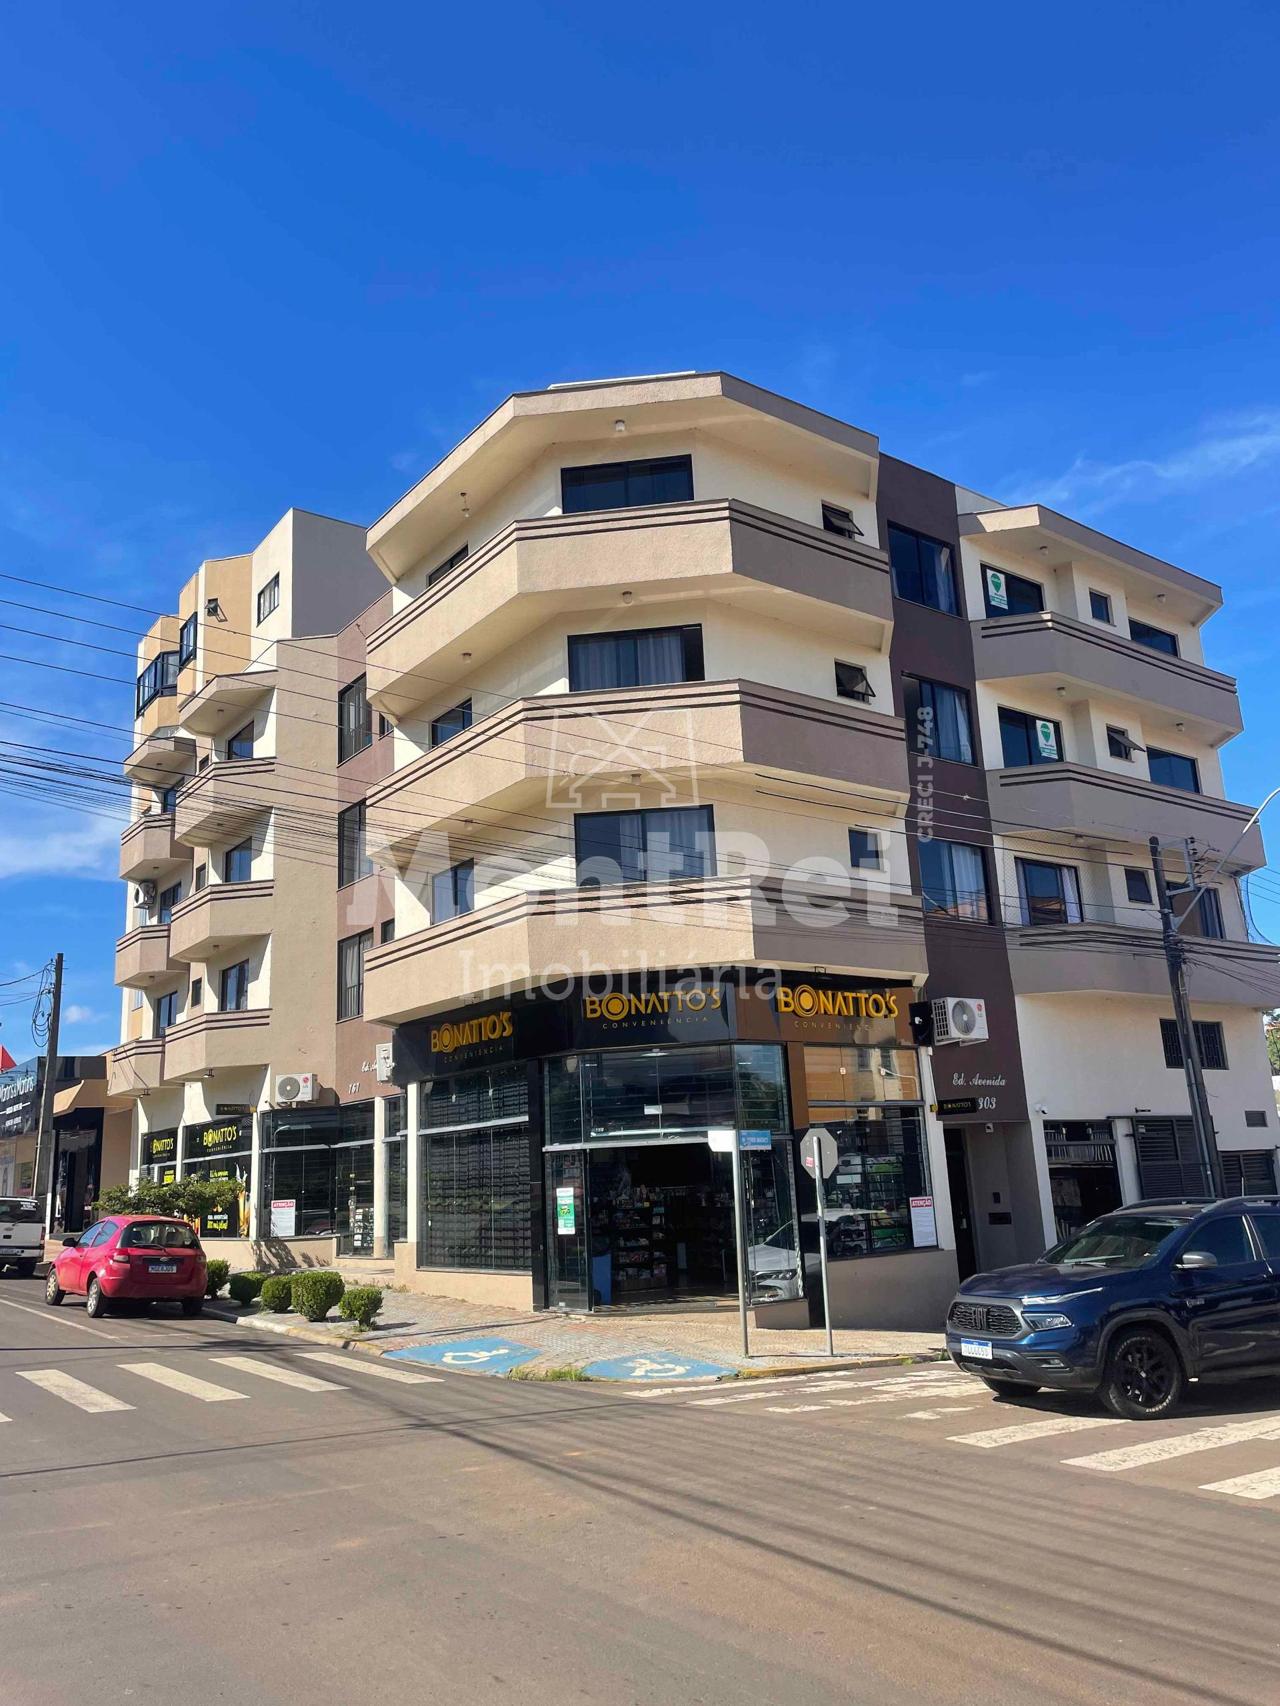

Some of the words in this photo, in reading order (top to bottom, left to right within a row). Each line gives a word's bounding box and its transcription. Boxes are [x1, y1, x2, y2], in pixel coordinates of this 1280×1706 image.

[585, 989, 721, 1021] BONATTO'S
[776, 984, 898, 1018] BONATTO'S
[431, 1011, 513, 1053] BONATTO'S
[952, 1072, 967, 1086] Ed.
[969, 1072, 1006, 1087] Avenida
[977, 1096, 997, 1110] 303
[203, 1124, 237, 1147] BONATTO'S
